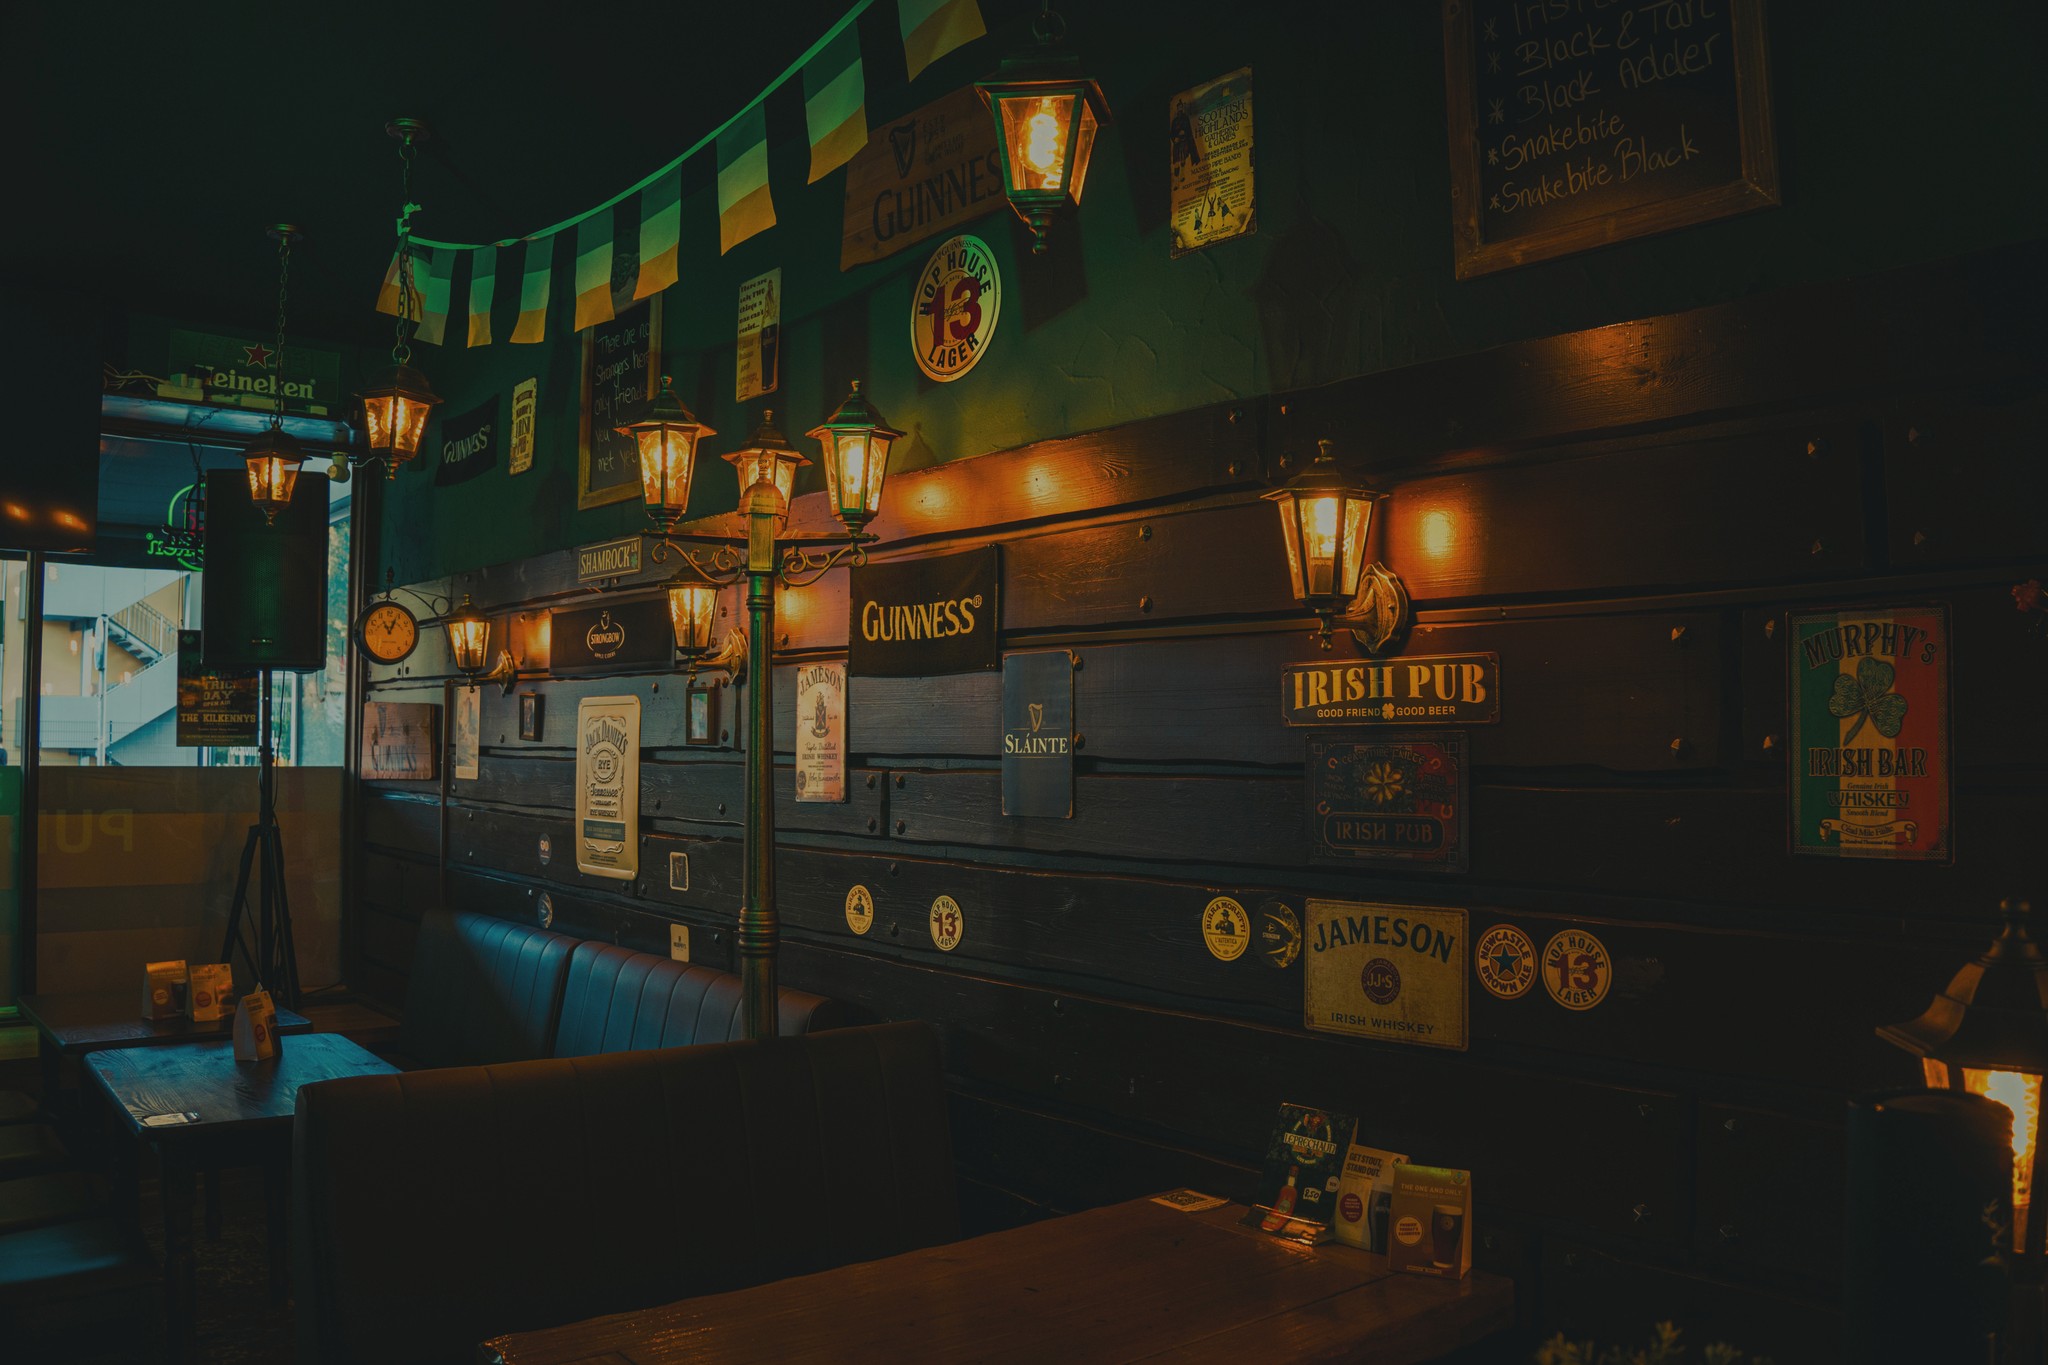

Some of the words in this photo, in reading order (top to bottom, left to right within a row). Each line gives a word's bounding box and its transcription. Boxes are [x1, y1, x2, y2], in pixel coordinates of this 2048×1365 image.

[1515, 23, 1611, 76] Black
[1617, 10, 1640, 49] &
[1516, 69, 1601, 124] Black
[1618, 32, 1720, 89] Adder
[1195, 109, 1248, 139] HIGHLANDS
[1198, 99, 1245, 126] SCOTTISH
[1501, 108, 1625, 171] Snakebite
[1501, 156, 1614, 213] Snakebite
[1613, 123, 1700, 183] Black
[873, 146, 1003, 242] GUINNES
[919, 266, 942, 316] HOP
[947, 248, 992, 297] HOUSE
[927, 277, 982, 346] 13
[928, 333, 980, 369] LAGER
[580, 545, 631, 575] SHAMROCK
[631, 542, 638, 553] LN
[800, 666, 843, 696] JAMESON
[1292, 665, 1395, 712] IRISH
[1407, 663, 1487, 704] PUB
[181, 713, 199, 723] THE
[203, 713, 257, 723] KILKENNYS
[1317, 708, 1344, 718] GOOD
[1346, 706, 1381, 718] FRIEND
[1396, 706, 1426, 717] GOOD
[1428, 705, 1457, 715] BEER
[1004, 732, 1068, 754] SLÁINTE
[598, 760, 611, 770] RYE
[1808, 747, 1874, 777] IRISH
[1878, 747, 1928, 778] BAR
[1827, 791, 1910, 808] WHISKEY
[1847, 782, 1873, 790] Genuine
[1873, 782, 1889, 790] Irish
[1847, 809, 1869, 817] Smooth
[1335, 820, 1386, 841] IRISH
[1395, 823, 1433, 843] PUB
[935, 912, 957, 937] 13
[1206, 903, 1222, 931] BIRRA
[1221, 901, 1247, 933] MORETTI
[1313, 915, 1456, 965] JAMESON
[1480, 930, 1531, 961] NEWCASTLE
[1548, 941, 1565, 968] HOP
[1569, 936, 1605, 970] HOUSE
[1480, 964, 1519, 993] BROWN
[1518, 964, 1533, 987] ALE
[1555, 953, 1599, 991] 13
[1557, 987, 1597, 1004] LAGER
[1331, 1011, 1366, 1026] IRISH
[1371, 1017, 1435, 1035] WHISKEY
[1284, 1133, 1336, 1155] LEPRECHAUN
[1349, 1152, 1361, 1163] GET
[1345, 1162, 1367, 1174] STAND
[1400, 1183, 1414, 1191] THE
[1414, 1184, 1428, 1193] ONE
[1429, 1186, 1444, 1194] AND
